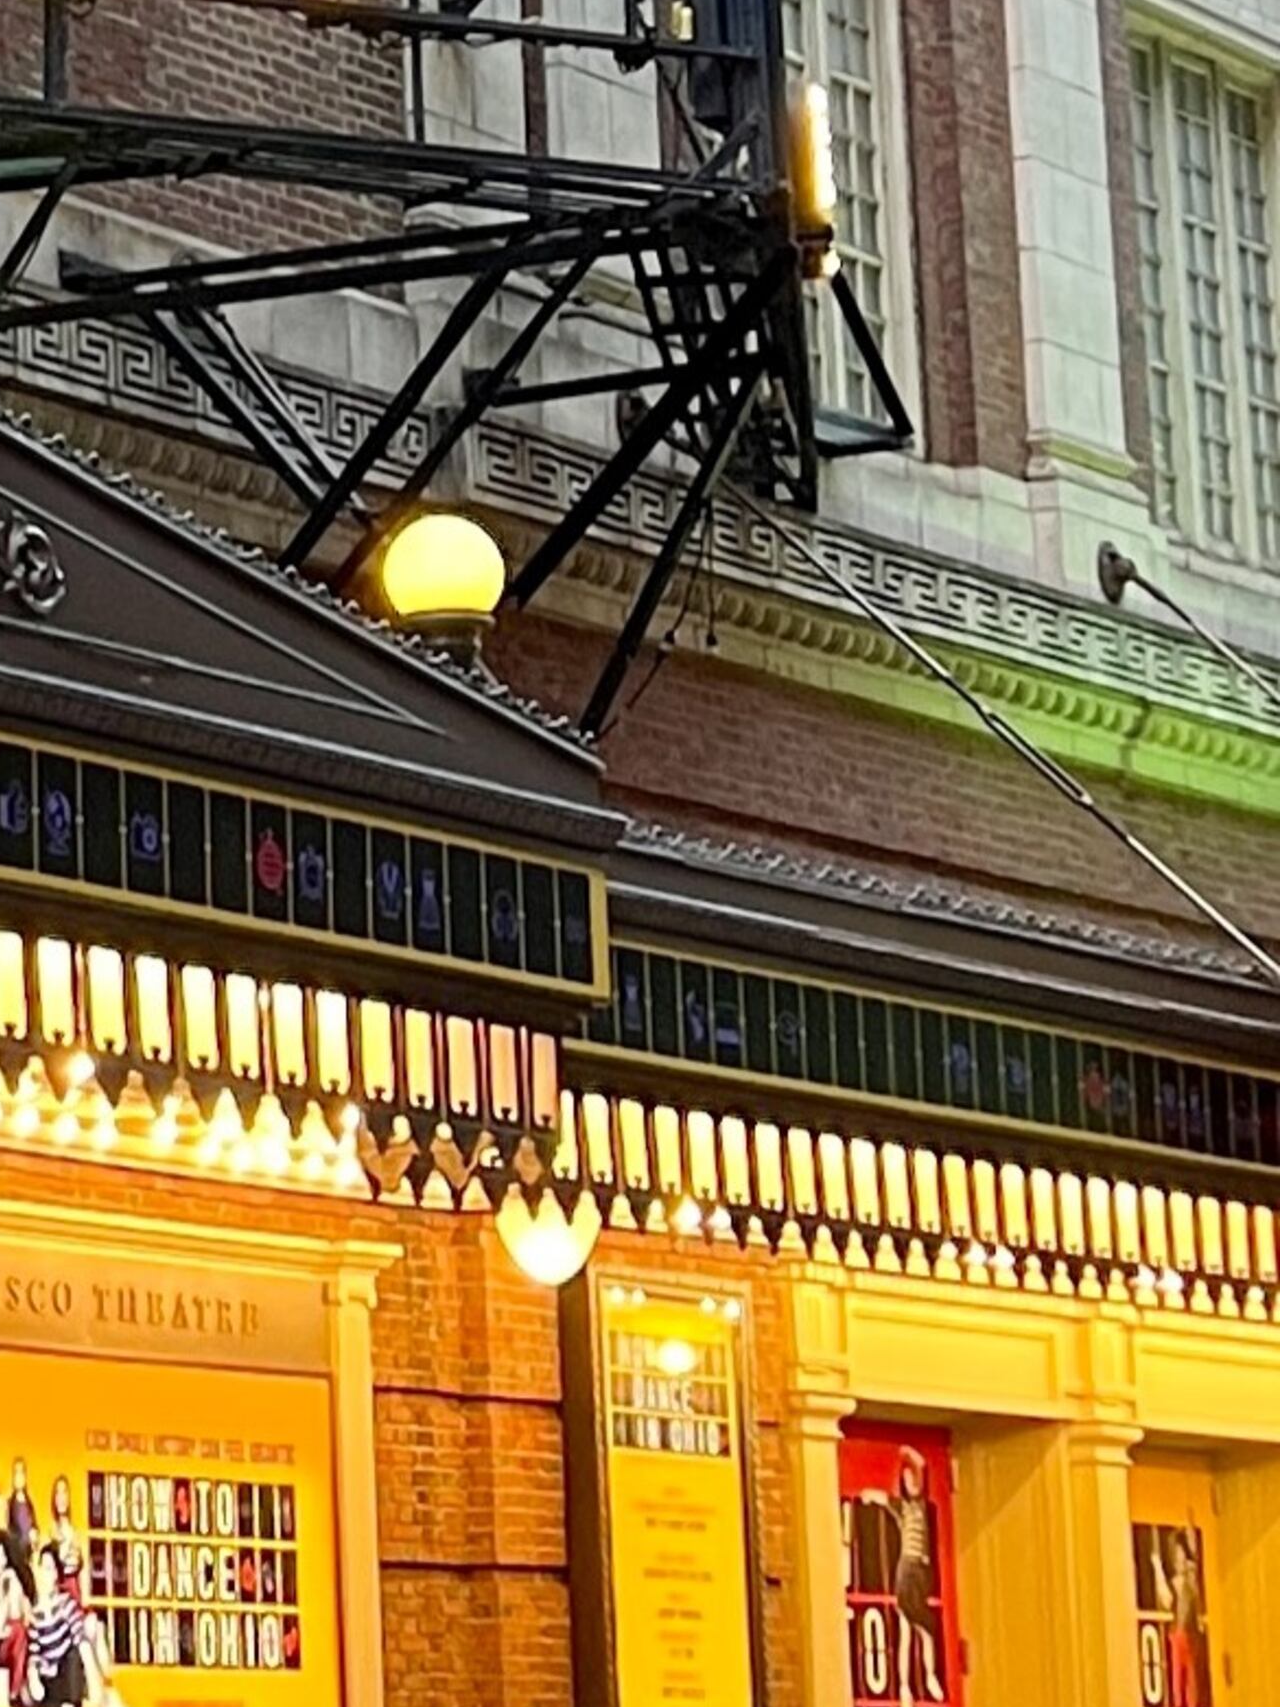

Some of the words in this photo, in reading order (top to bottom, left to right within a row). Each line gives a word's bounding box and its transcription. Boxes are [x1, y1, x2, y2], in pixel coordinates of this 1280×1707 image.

[92, 1282, 262, 1339] THEATRE
[669, 1418, 720, 1457] OHIO
[108, 1474, 173, 1532] HOW
[195, 1480, 235, 1537] TO
[132, 1541, 239, 1601] DANCE
[138, 1608, 177, 1665] IN
[198, 1610, 283, 1669] OHIO
